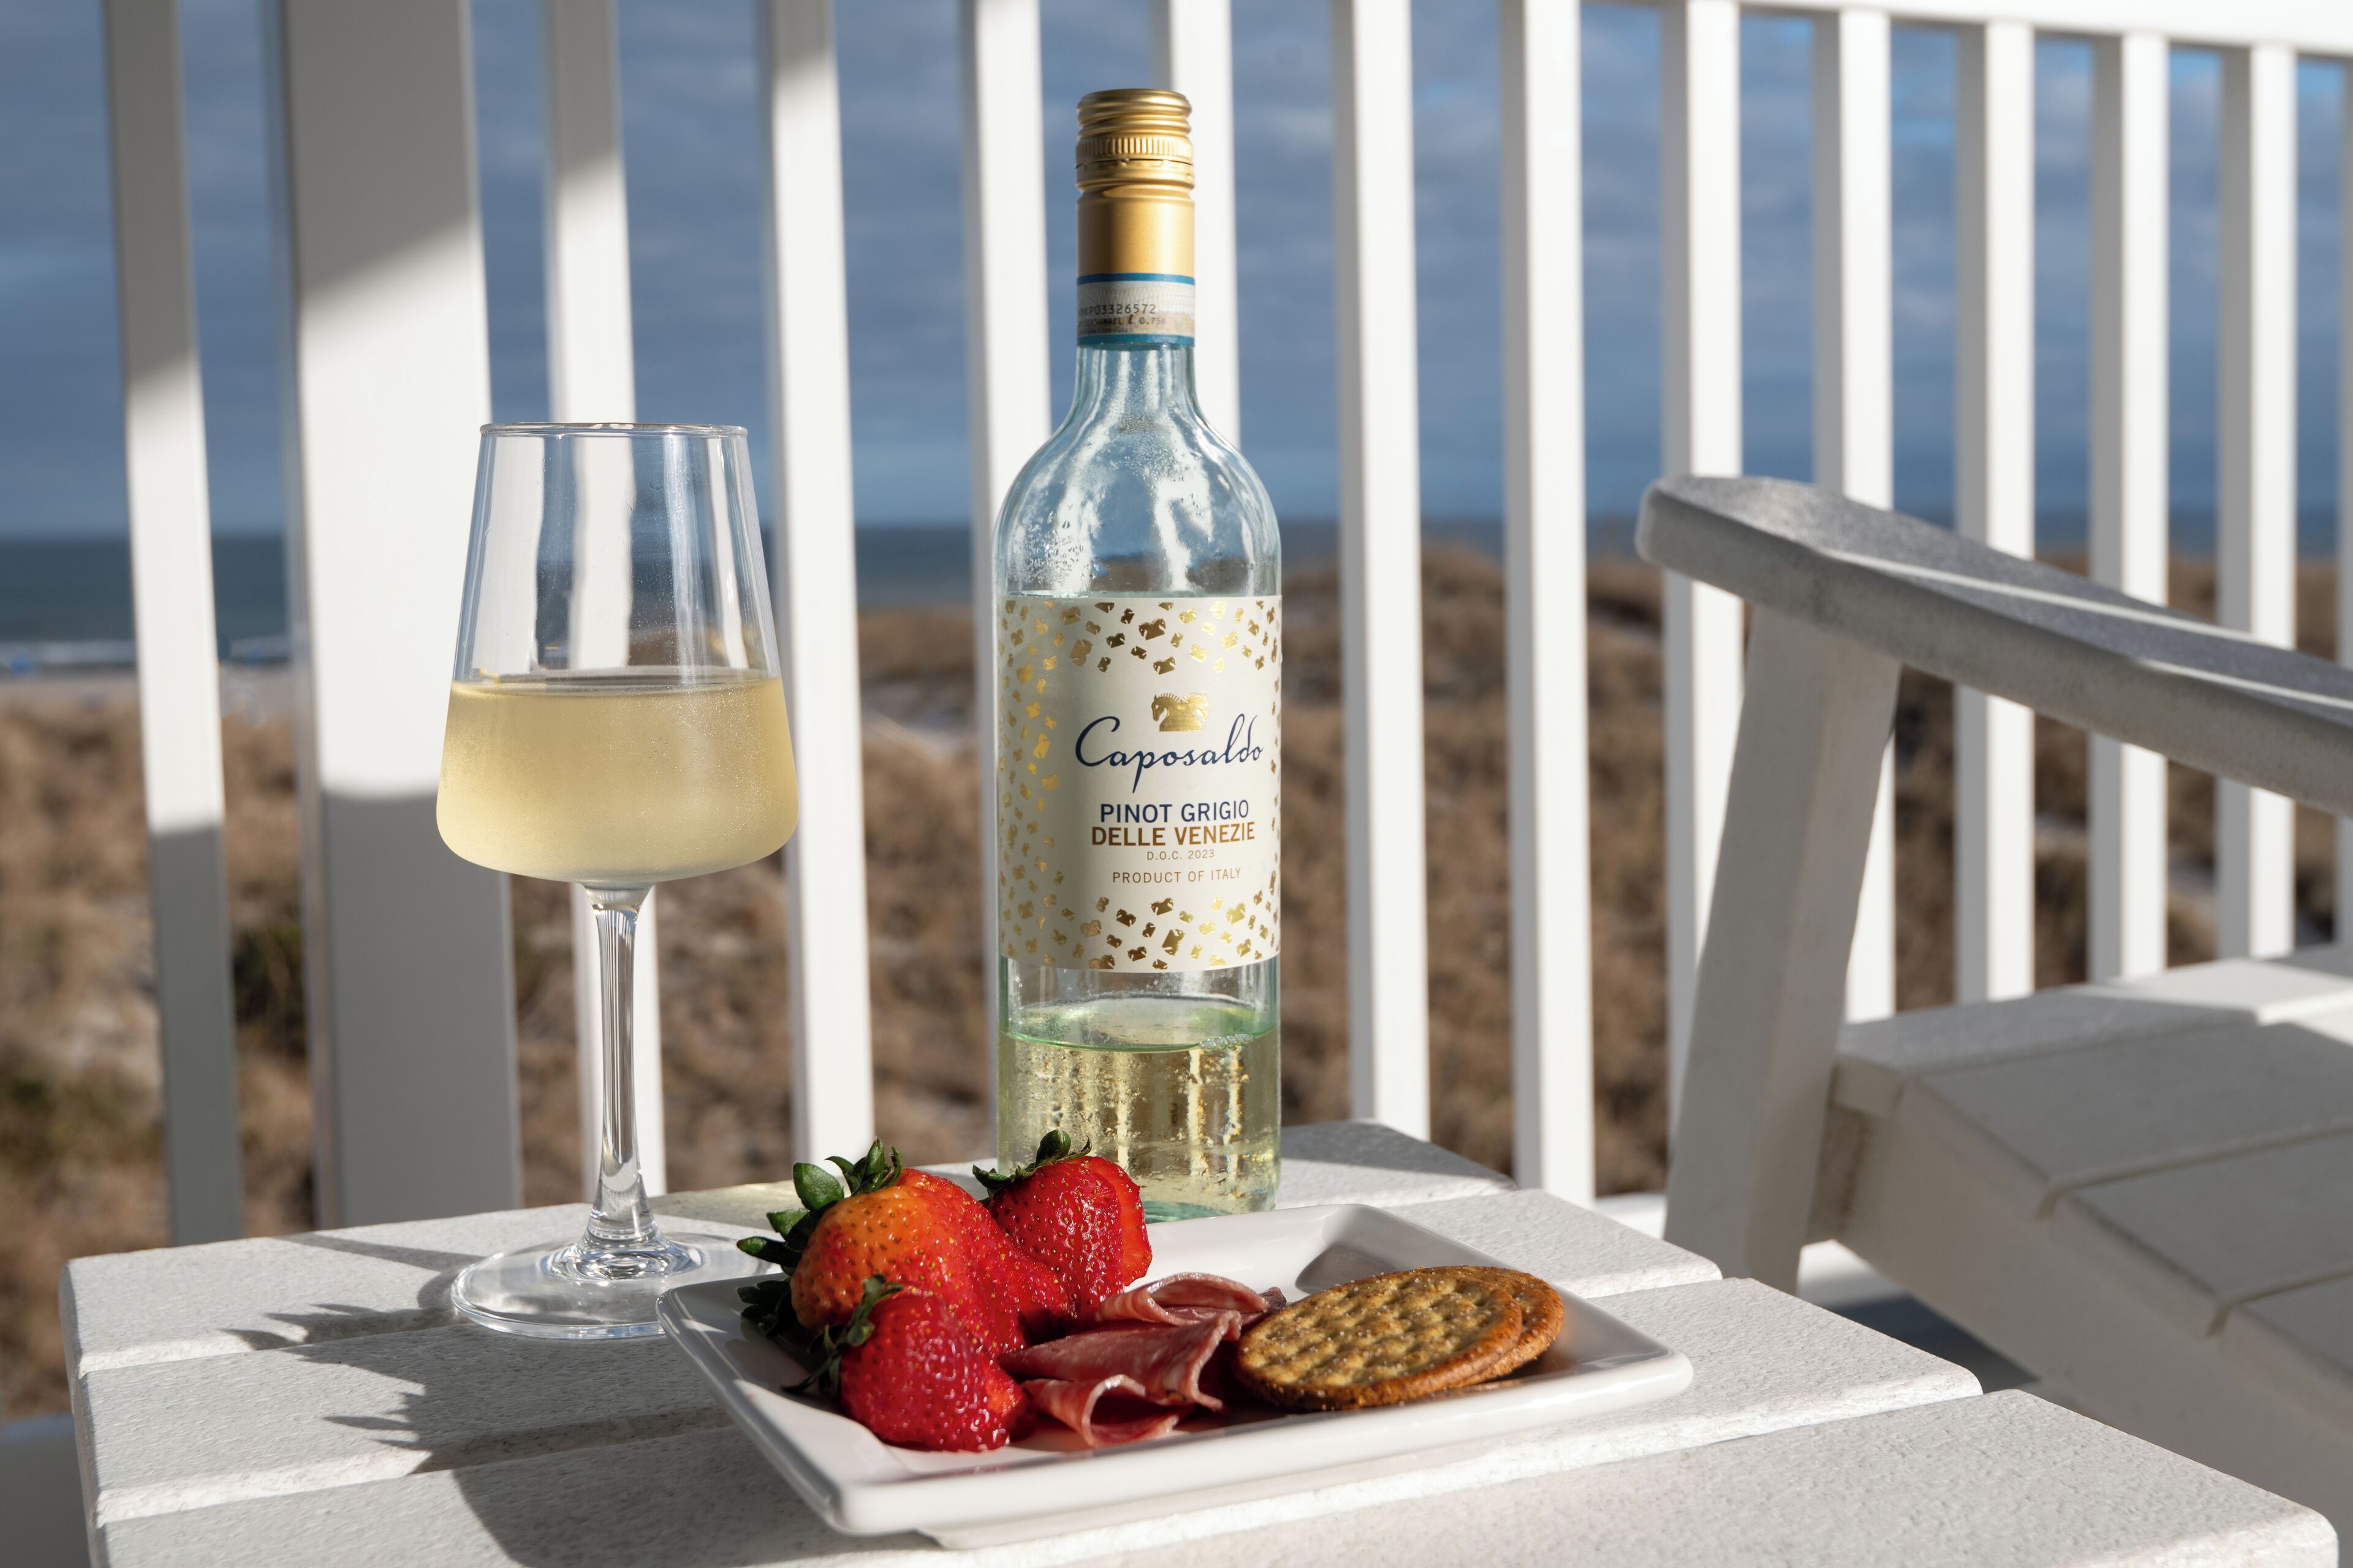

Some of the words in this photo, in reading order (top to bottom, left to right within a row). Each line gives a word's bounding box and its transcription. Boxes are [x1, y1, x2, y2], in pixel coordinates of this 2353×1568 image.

[1075, 713, 1264, 793] Caposaldo
[1101, 804, 1172, 823] PINOT
[1181, 800, 1249, 822] GRIGIO
[1091, 827, 1165, 846] DELLE
[1174, 821, 1255, 846] VENEZIE
[1146, 850, 1182, 860] D.O.C.
[1188, 849, 1214, 859] 2023
[1113, 871, 1181, 883] PRODUCT
[1188, 871, 1205, 882] OF
[1211, 868, 1241, 881] ITALY
